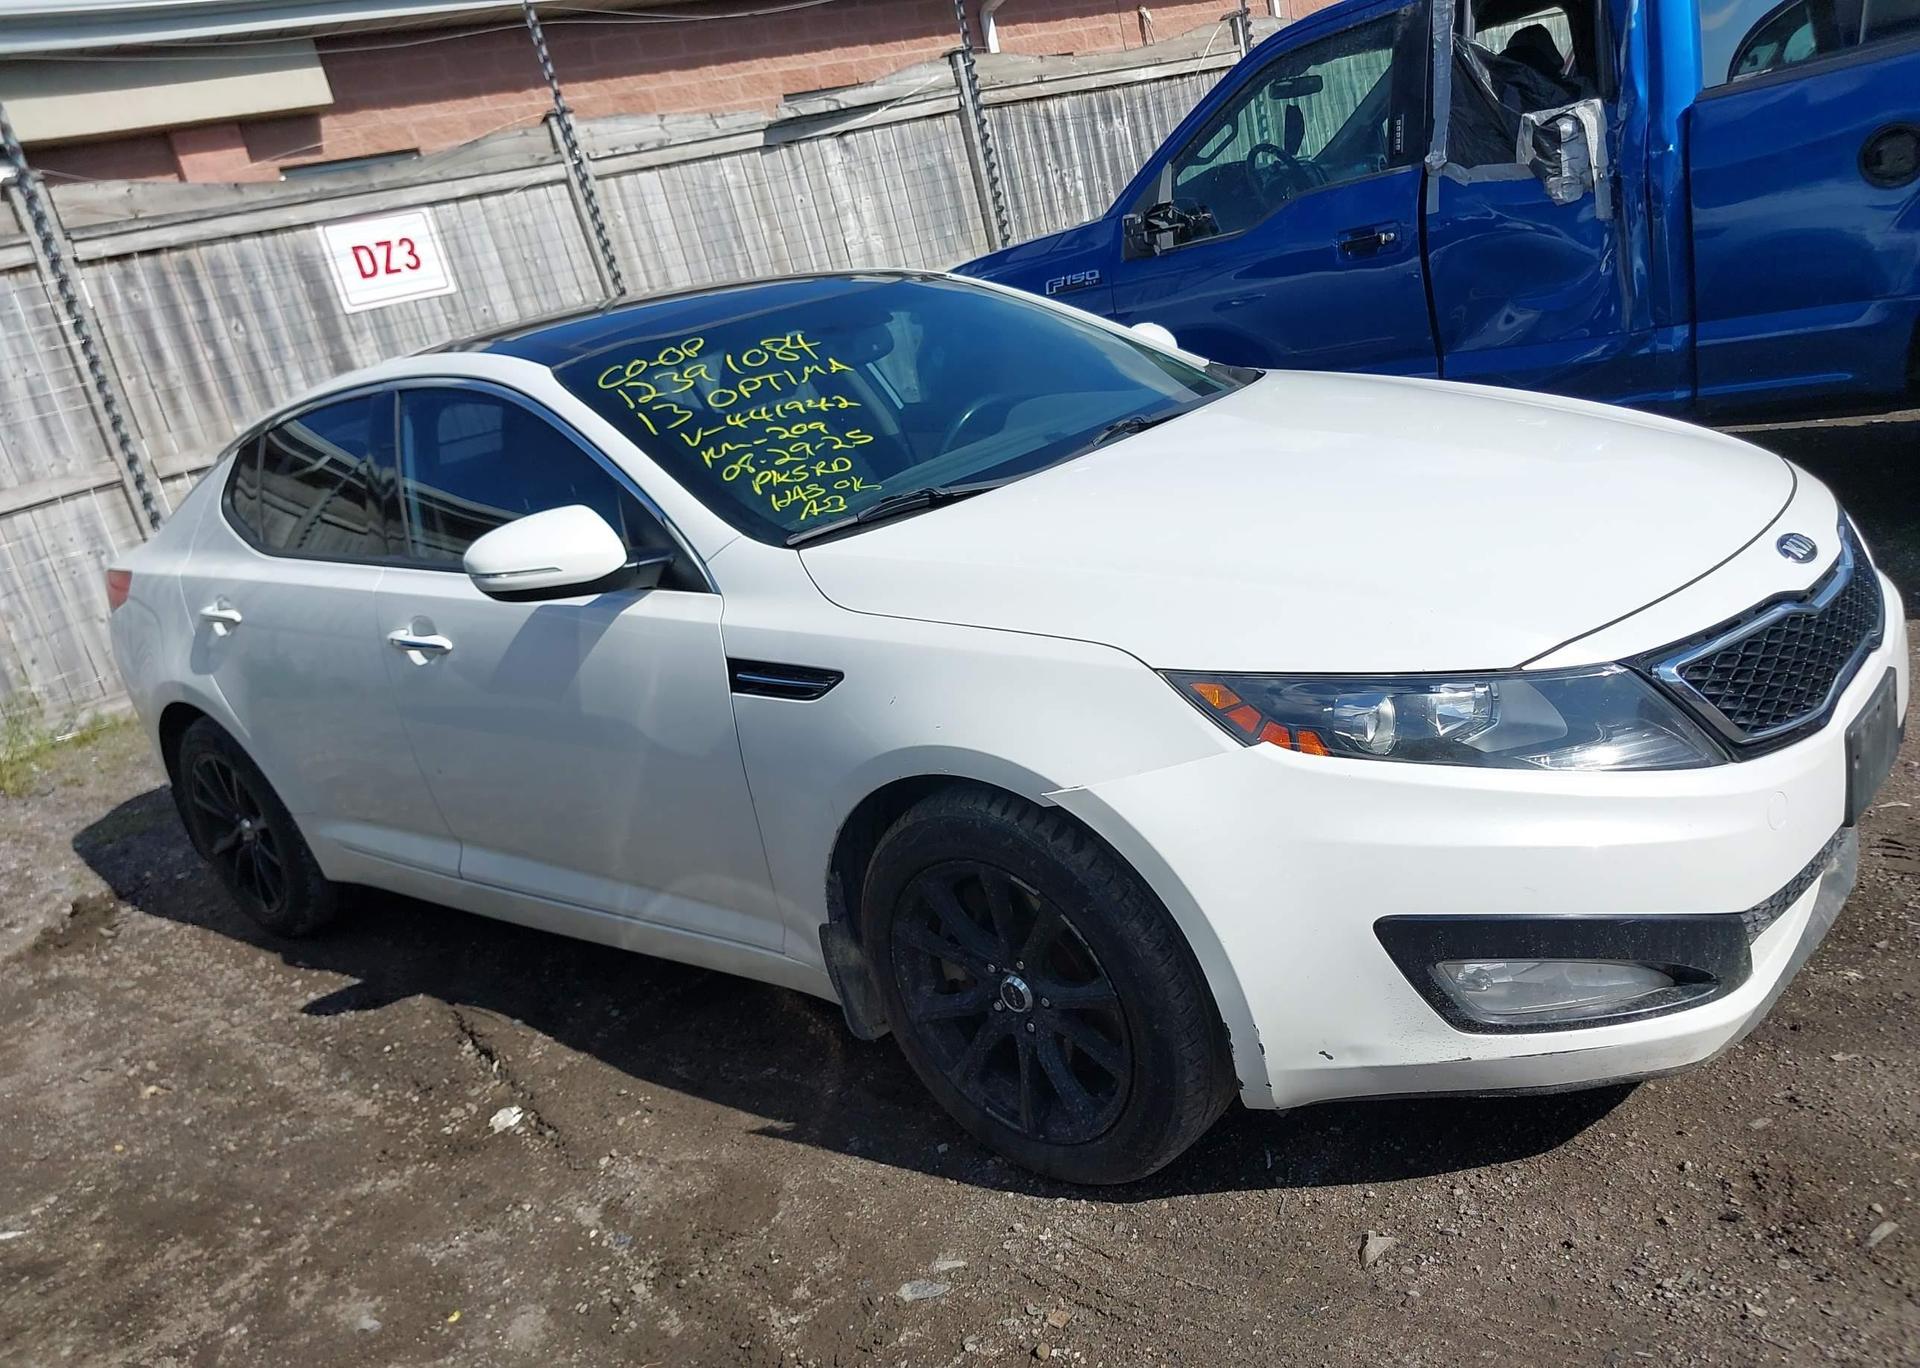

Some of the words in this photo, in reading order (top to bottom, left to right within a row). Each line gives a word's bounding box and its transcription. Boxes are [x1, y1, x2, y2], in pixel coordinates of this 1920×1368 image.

[352, 238, 421, 279] DZ3
[637, 404, 693, 435] 13
[707, 357, 855, 407] OPTIMA
